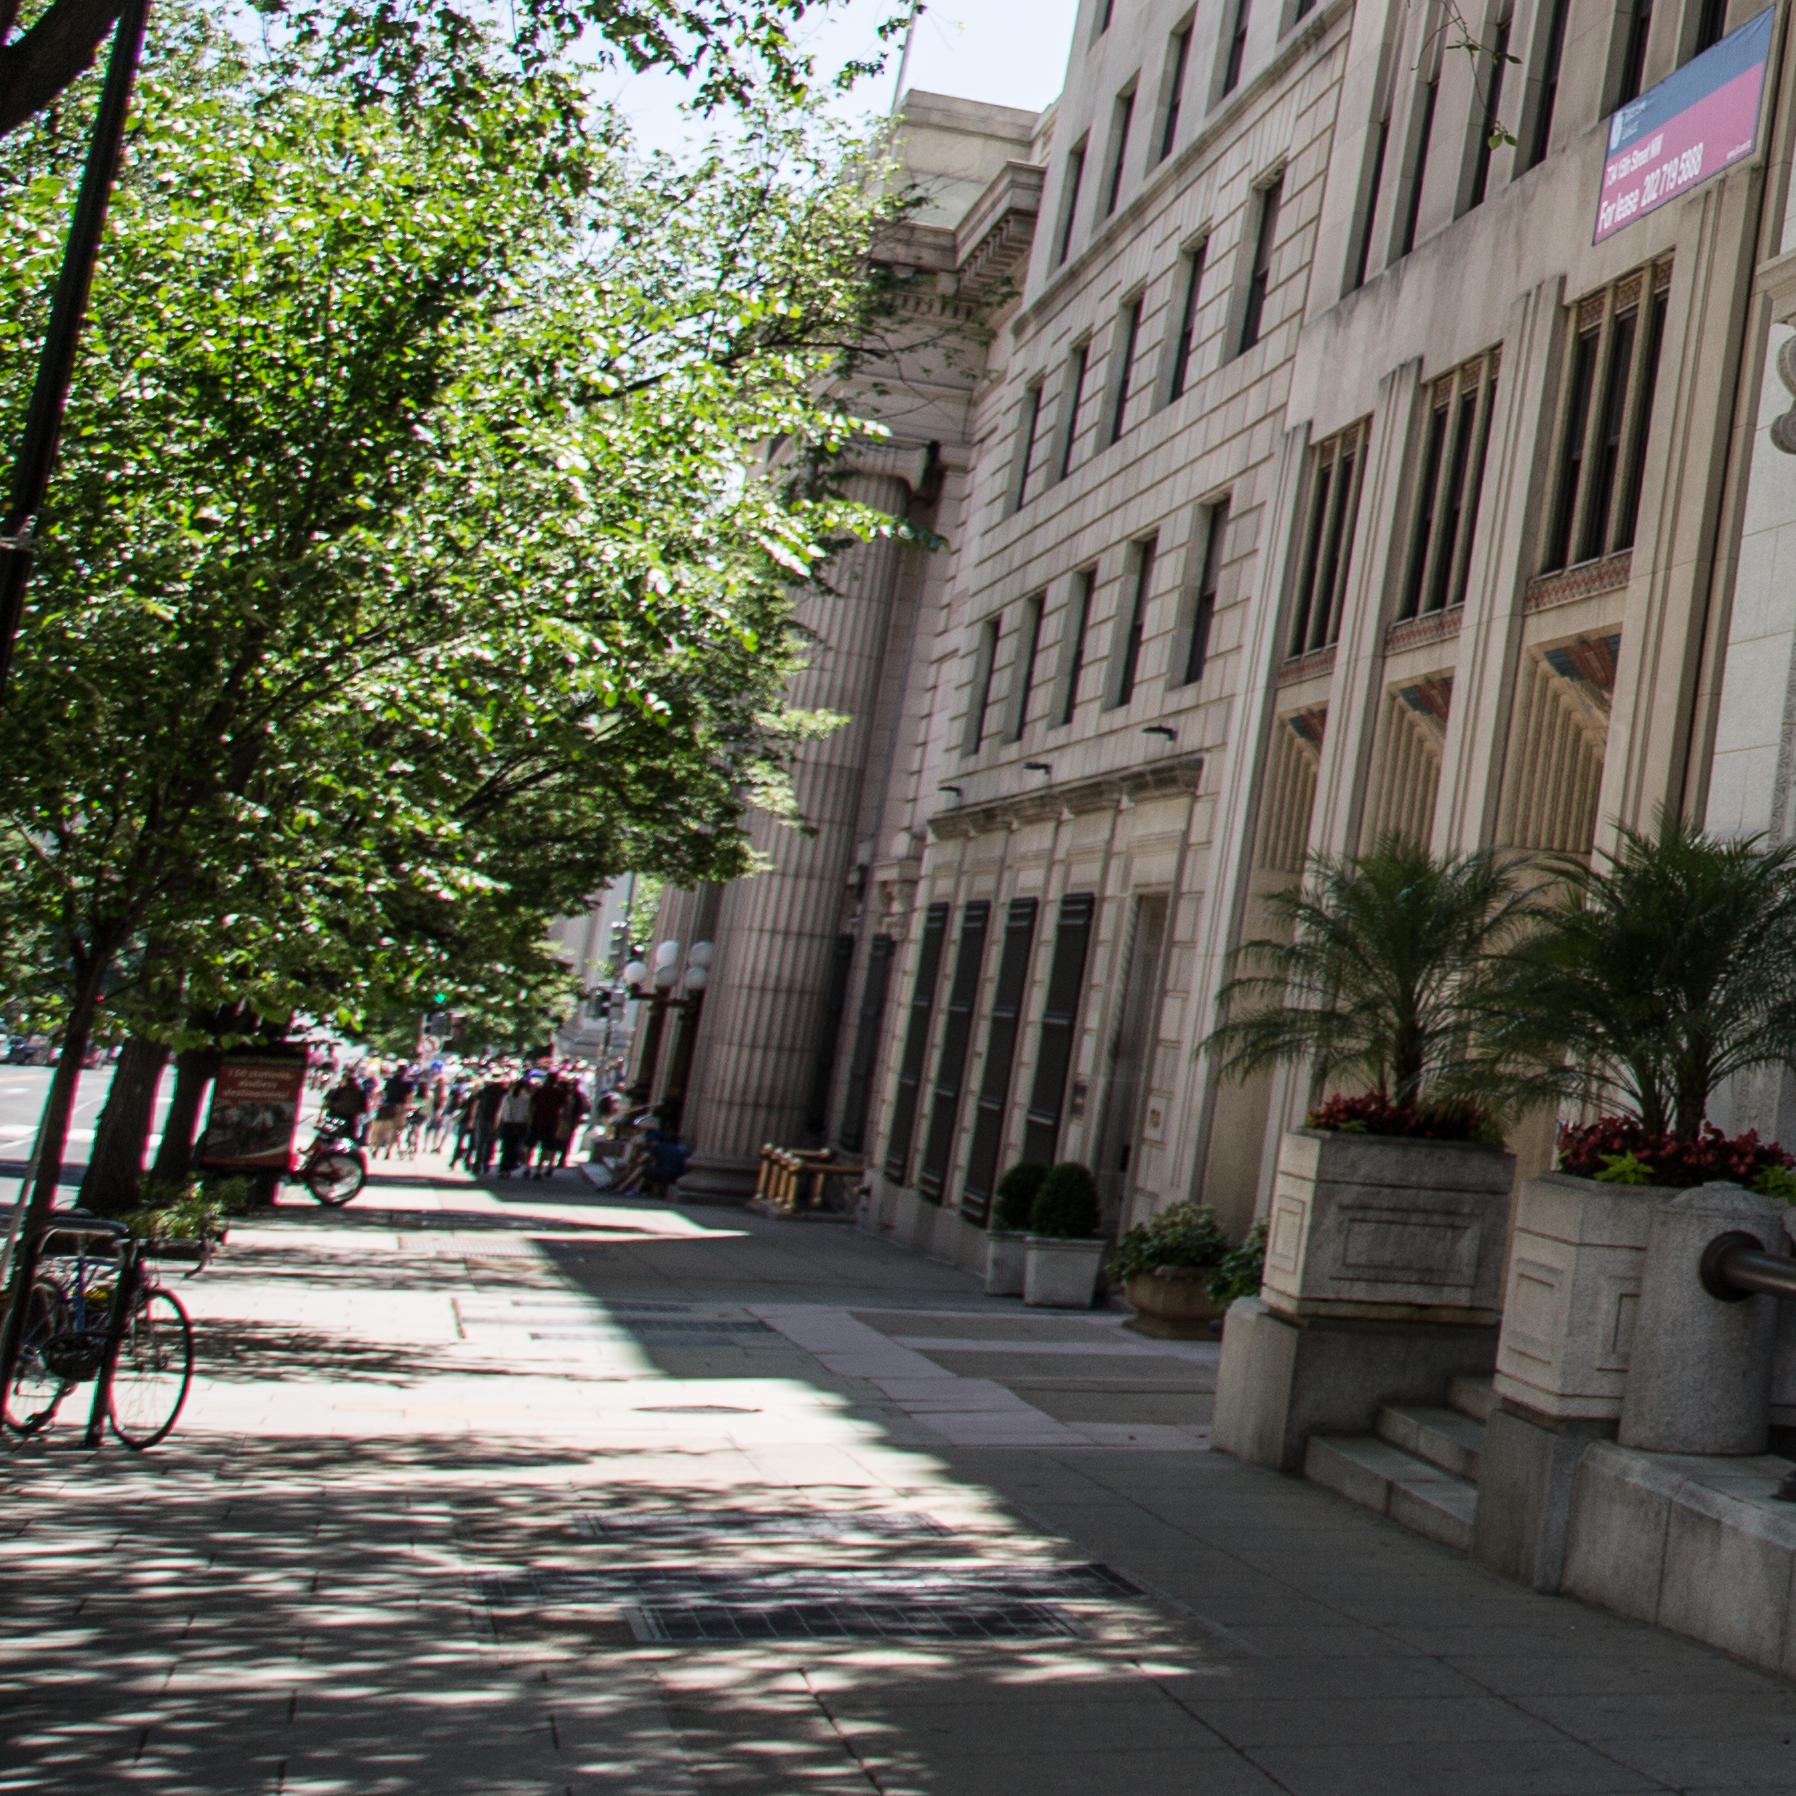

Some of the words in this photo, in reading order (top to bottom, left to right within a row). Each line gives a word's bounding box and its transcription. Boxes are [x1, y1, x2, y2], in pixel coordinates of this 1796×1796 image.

[1630, 145, 1651, 173] Street
[1650, 133, 1664, 159] NW
[1598, 200, 1616, 233] For
[1614, 189, 1639, 223] lease
[1640, 168, 1661, 207] 202
[1659, 157, 1679, 196] 719
